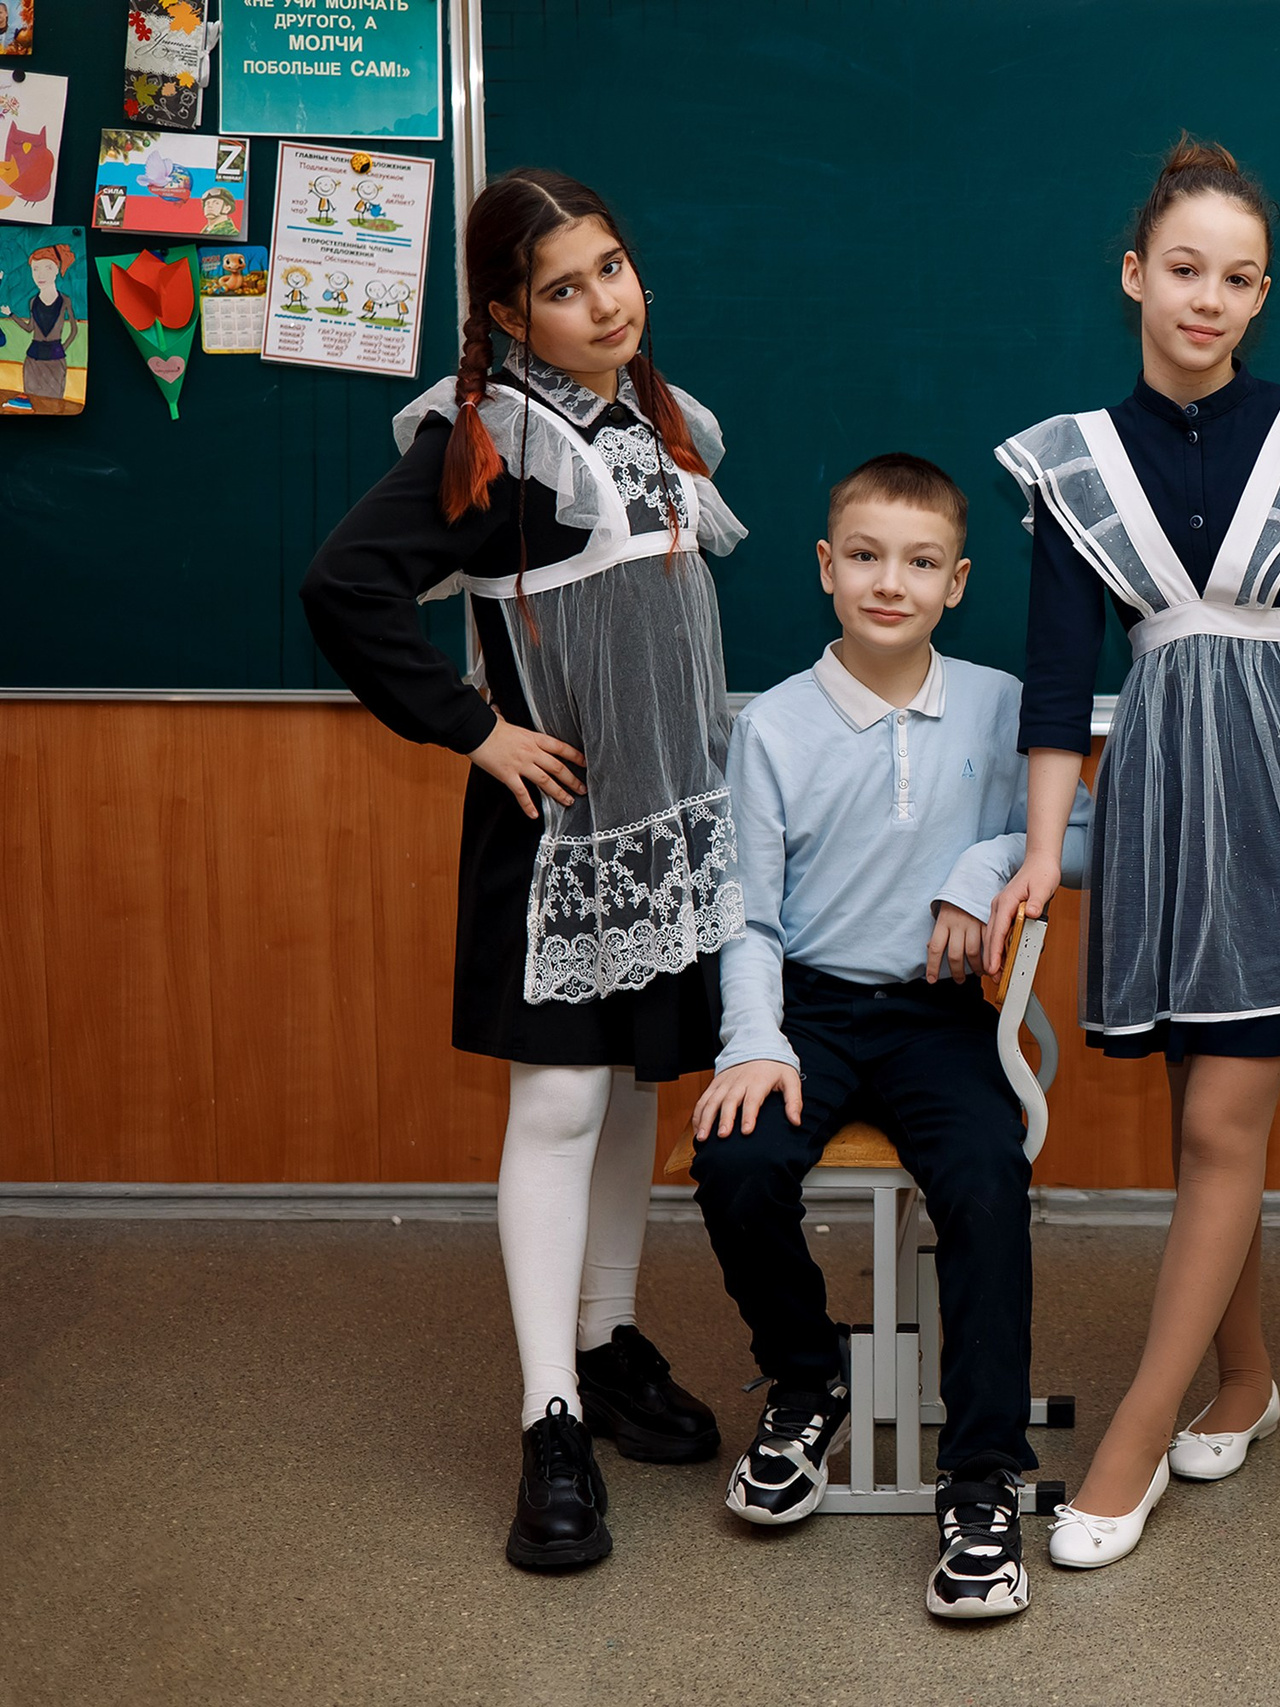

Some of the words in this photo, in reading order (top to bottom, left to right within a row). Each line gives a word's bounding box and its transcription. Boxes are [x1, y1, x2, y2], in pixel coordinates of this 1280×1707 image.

[284, 0, 316, 8] УЧИ
[326, 0, 409, 11] МОЛЧАТЬ
[274, 13, 356, 31] ДРУГОГО,
[364, 16, 378, 30] А
[289, 35, 363, 52] МОЛЧИ
[243, 60, 341, 76] ПОБОЛЬШЕ
[351, 60, 411, 77] САМ!»
[218, 145, 242, 175] Z
[295, 152, 329, 161] ГЛАВНЫЕ
[101, 195, 126, 220] V
[302, 237, 367, 249] ВТОРОСТЕПЕННЫЕ
[320, 246, 375, 258] ПРЕДЛОЖЕНИЯ
